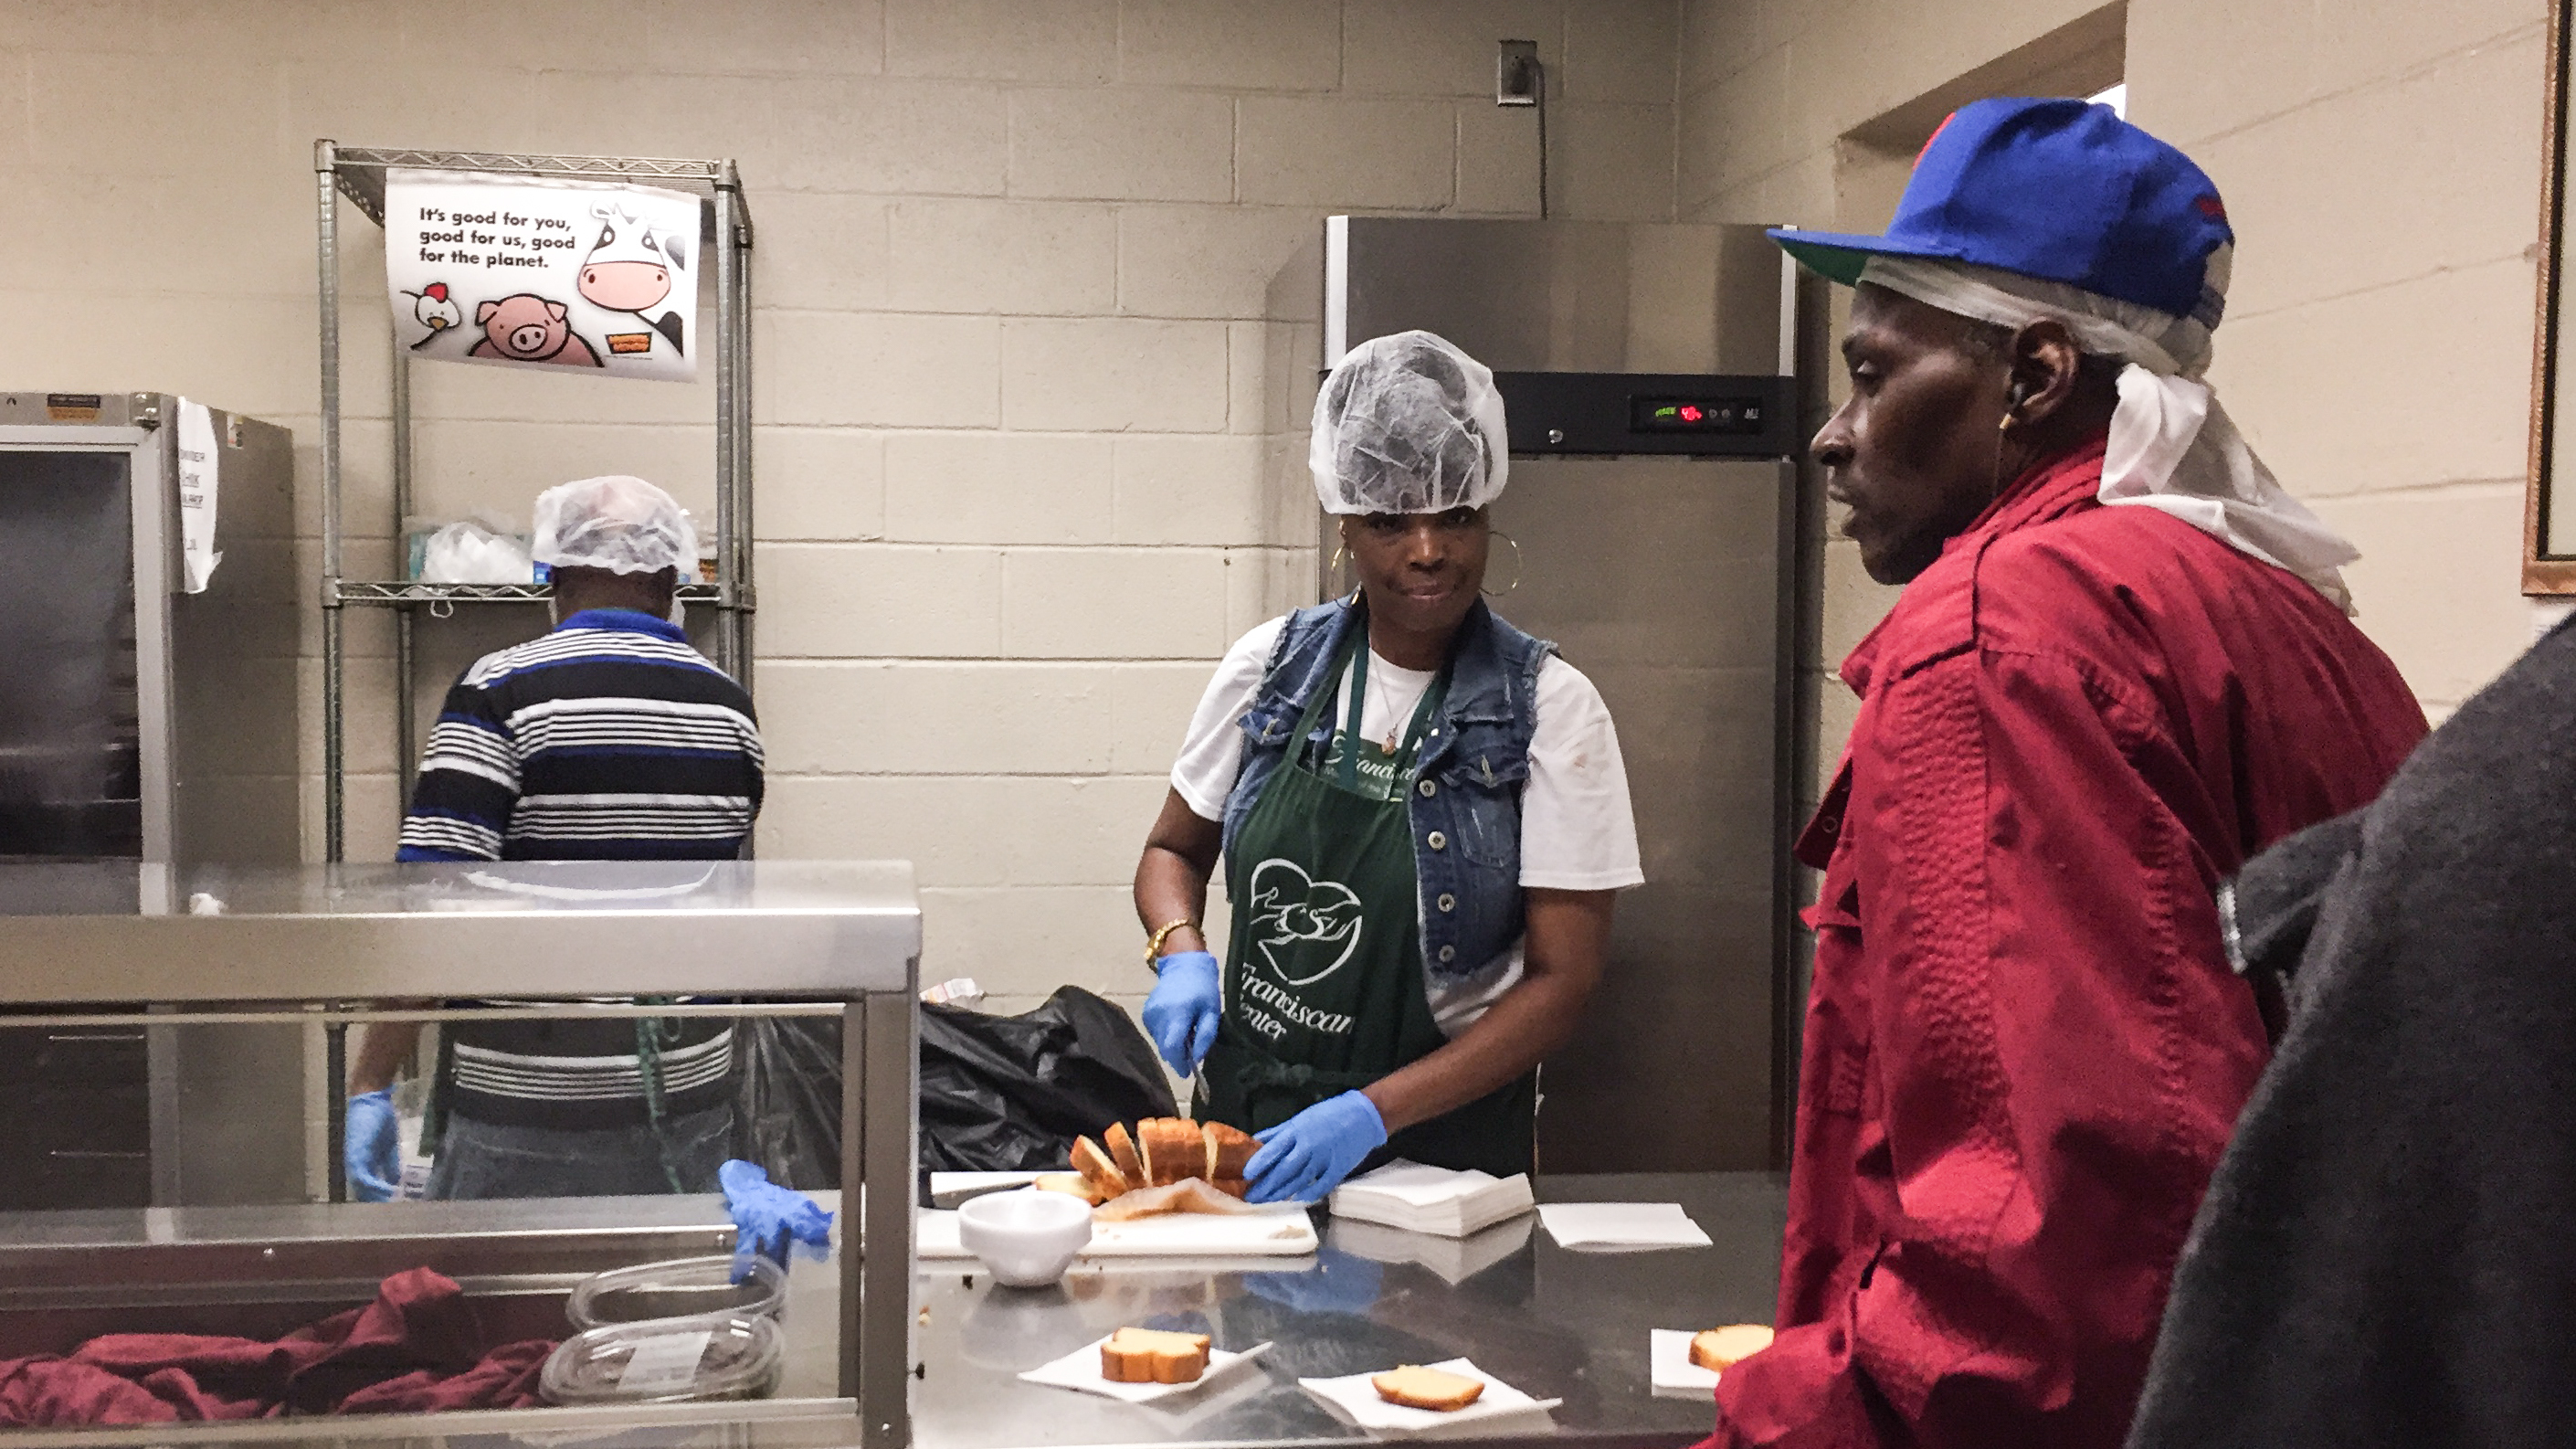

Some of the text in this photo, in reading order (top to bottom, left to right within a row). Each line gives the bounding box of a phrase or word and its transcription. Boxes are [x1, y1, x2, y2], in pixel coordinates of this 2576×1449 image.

[419, 207, 571, 232] It's good for you,
[419, 229, 575, 251] good for us, good
[419, 248, 549, 269] for the planet.
[1240, 993, 1287, 1040] enter
